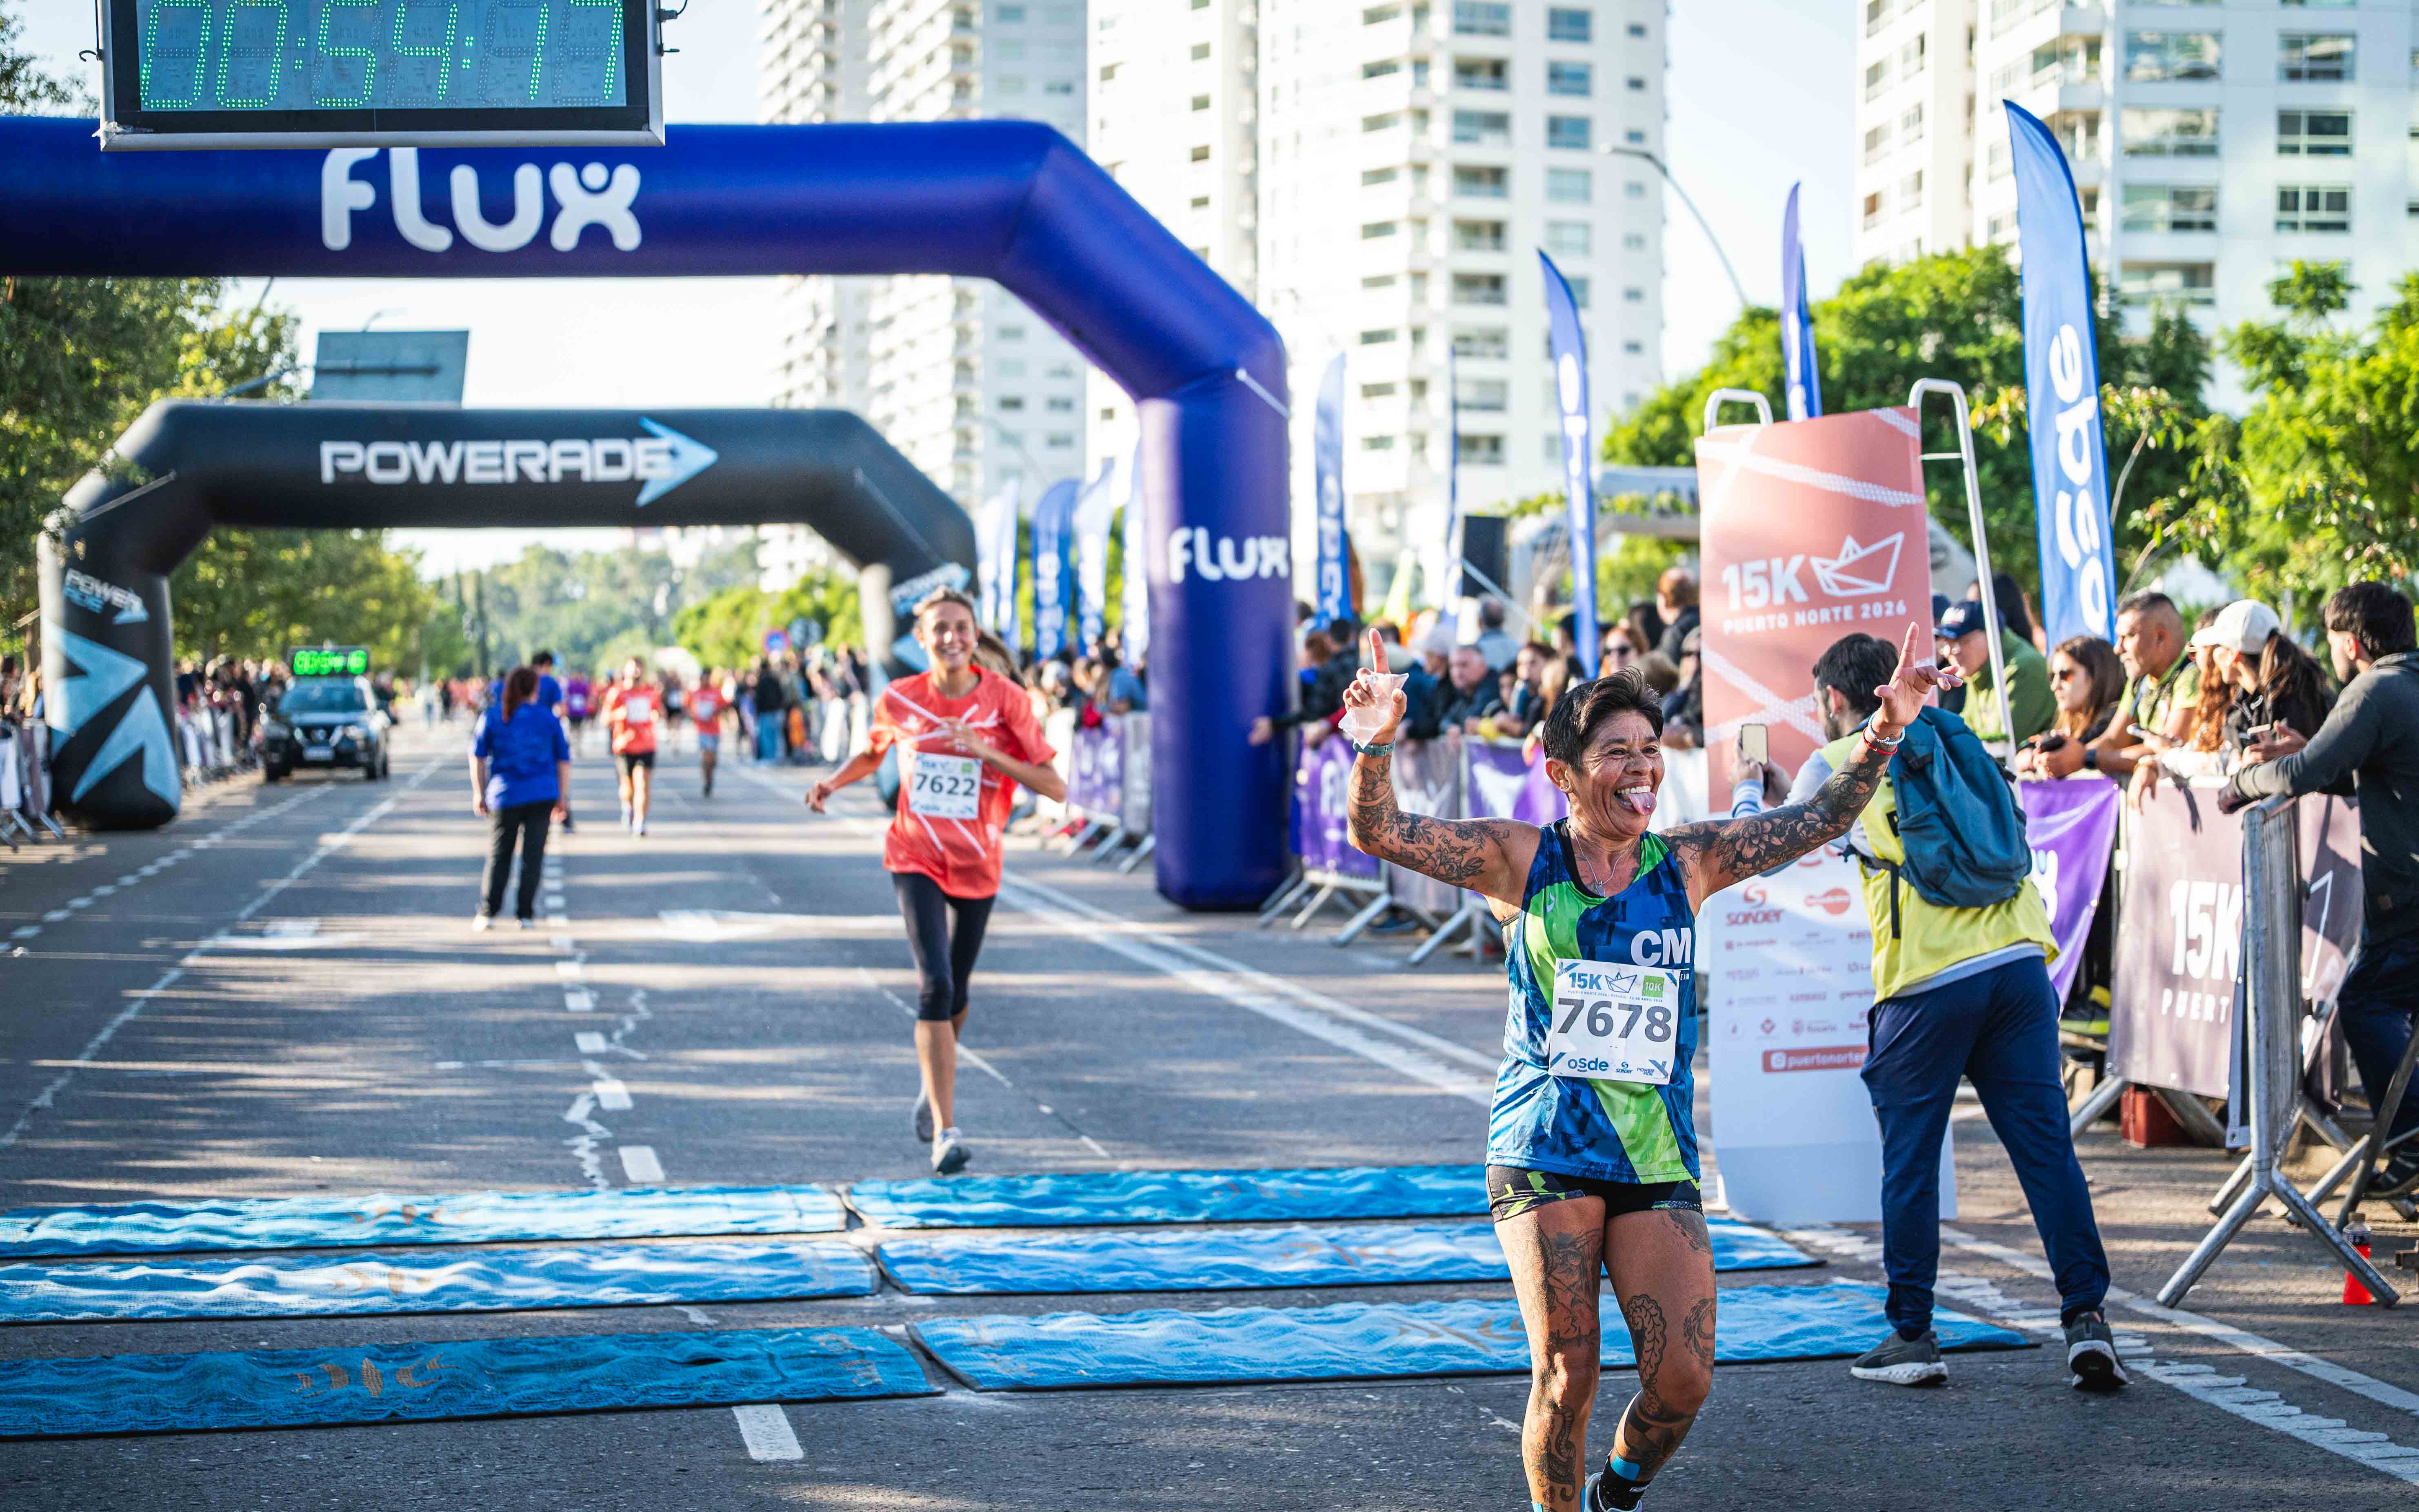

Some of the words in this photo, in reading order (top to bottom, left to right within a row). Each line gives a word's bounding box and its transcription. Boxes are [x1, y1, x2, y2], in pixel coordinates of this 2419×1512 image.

[140, 0, 624, 108] 00:54:17
[321, 147, 642, 253] flux
[320, 438, 673, 484] POWERADE
[1168, 526, 1289, 584] flux
[1721, 554, 1809, 611] 15K
[1724, 613, 1788, 635] PUERTO
[1795, 605, 1854, 627] NORTE
[1861, 600, 1907, 620] 2026
[916, 773, 975, 796] 7622
[1631, 927, 1692, 966] CM
[2168, 879, 2244, 983] 15K
[1569, 972, 1602, 990] 15K
[1645, 981, 1661, 992] 10K
[1557, 997, 1672, 1043] 7678
[2161, 987, 2230, 1024] PUERT
[1568, 1057, 1609, 1072] osde
